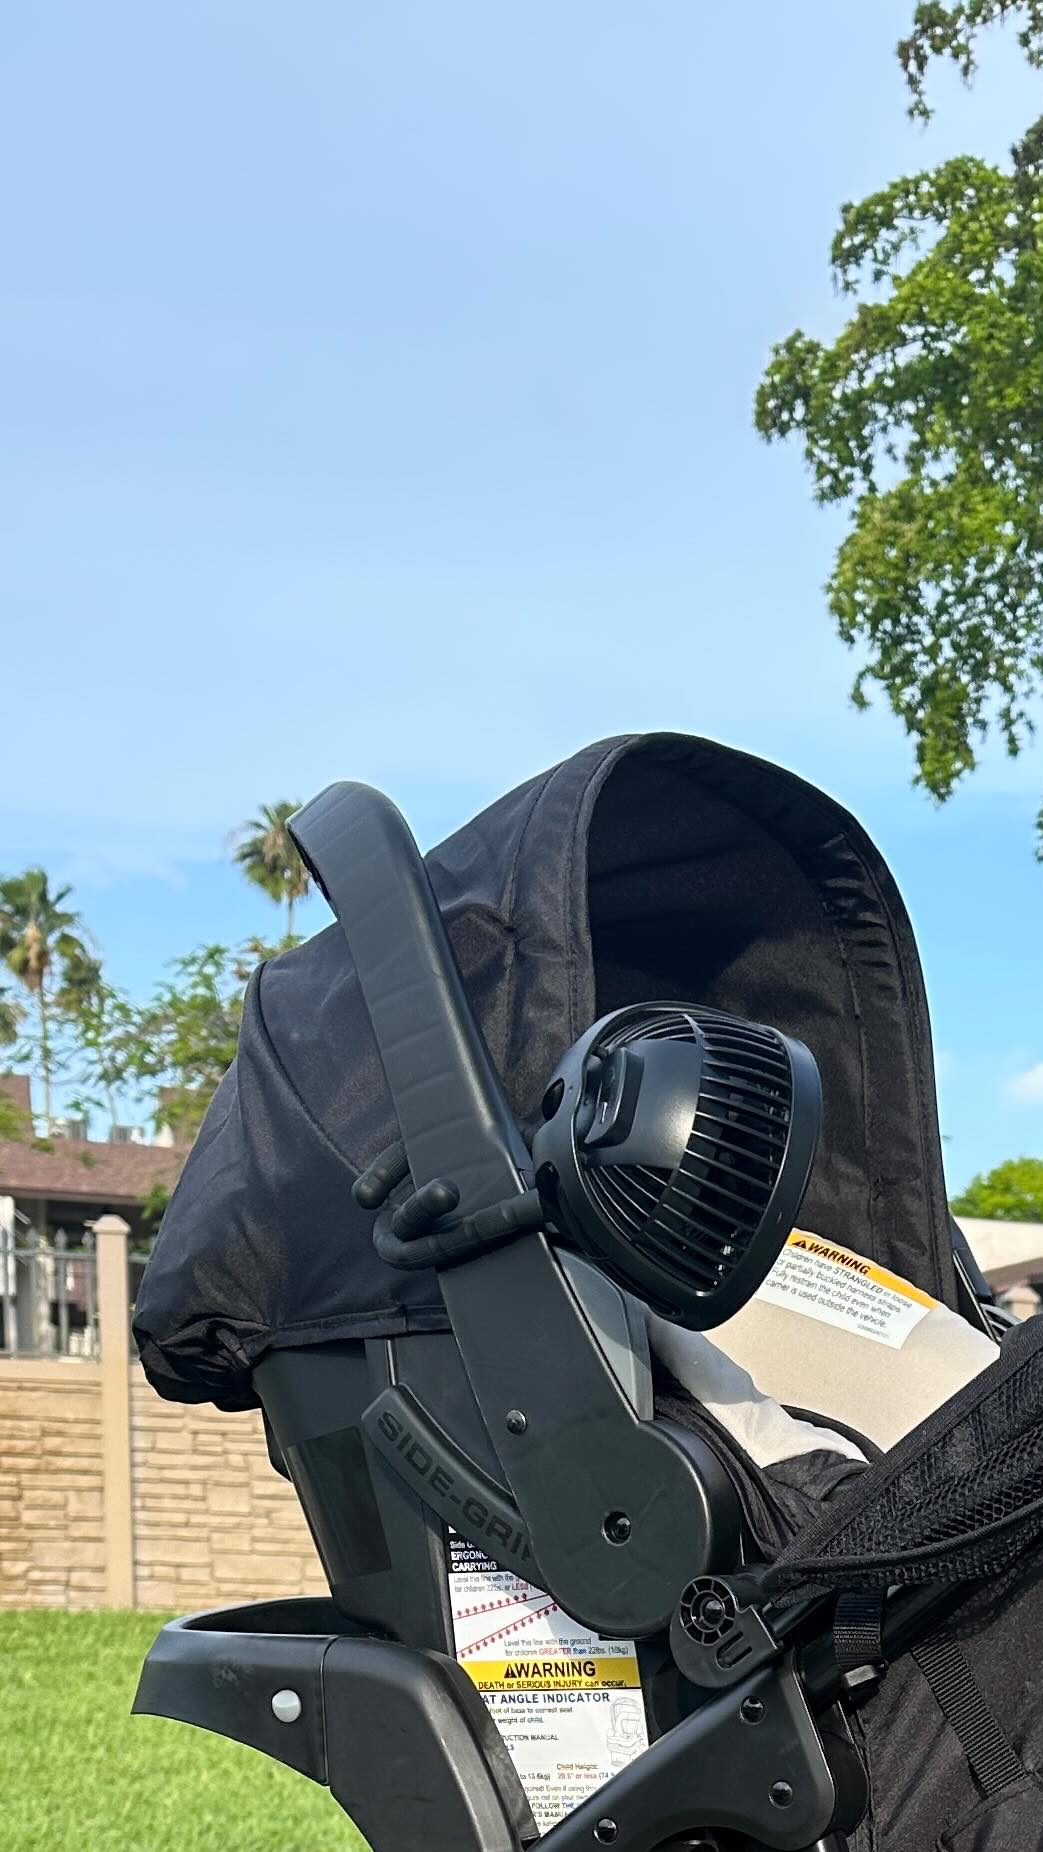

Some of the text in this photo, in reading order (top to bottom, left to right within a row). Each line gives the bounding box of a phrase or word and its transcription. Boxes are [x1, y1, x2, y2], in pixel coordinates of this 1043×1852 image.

[808, 1242, 871, 1275] WARNING
[784, 1260, 815, 1277] partially
[815, 1270, 847, 1289] buckled
[846, 1283, 877, 1301] harness
[814, 1259, 833, 1272] have
[833, 1267, 884, 1294] STRANGLED
[797, 1288, 819, 1302] used
[818, 1296, 846, 1313] outside
[845, 1307, 859, 1318] the
[818, 1284, 831, 1295] the
[850, 1297, 870, 1310] even
[451, 1560, 498, 1572] CARRYING
[516, 1660, 597, 1679] WARNING
[478, 1681, 505, 1690] DEATH
[516, 1680, 552, 1689] SERIOUS
[553, 1679, 583, 1689] INJURY
[584, 1680, 600, 1688] can
[481, 1692, 611, 1705] AT ANGLE INDICATOR
[530, 1733, 560, 1741] MANUAL
